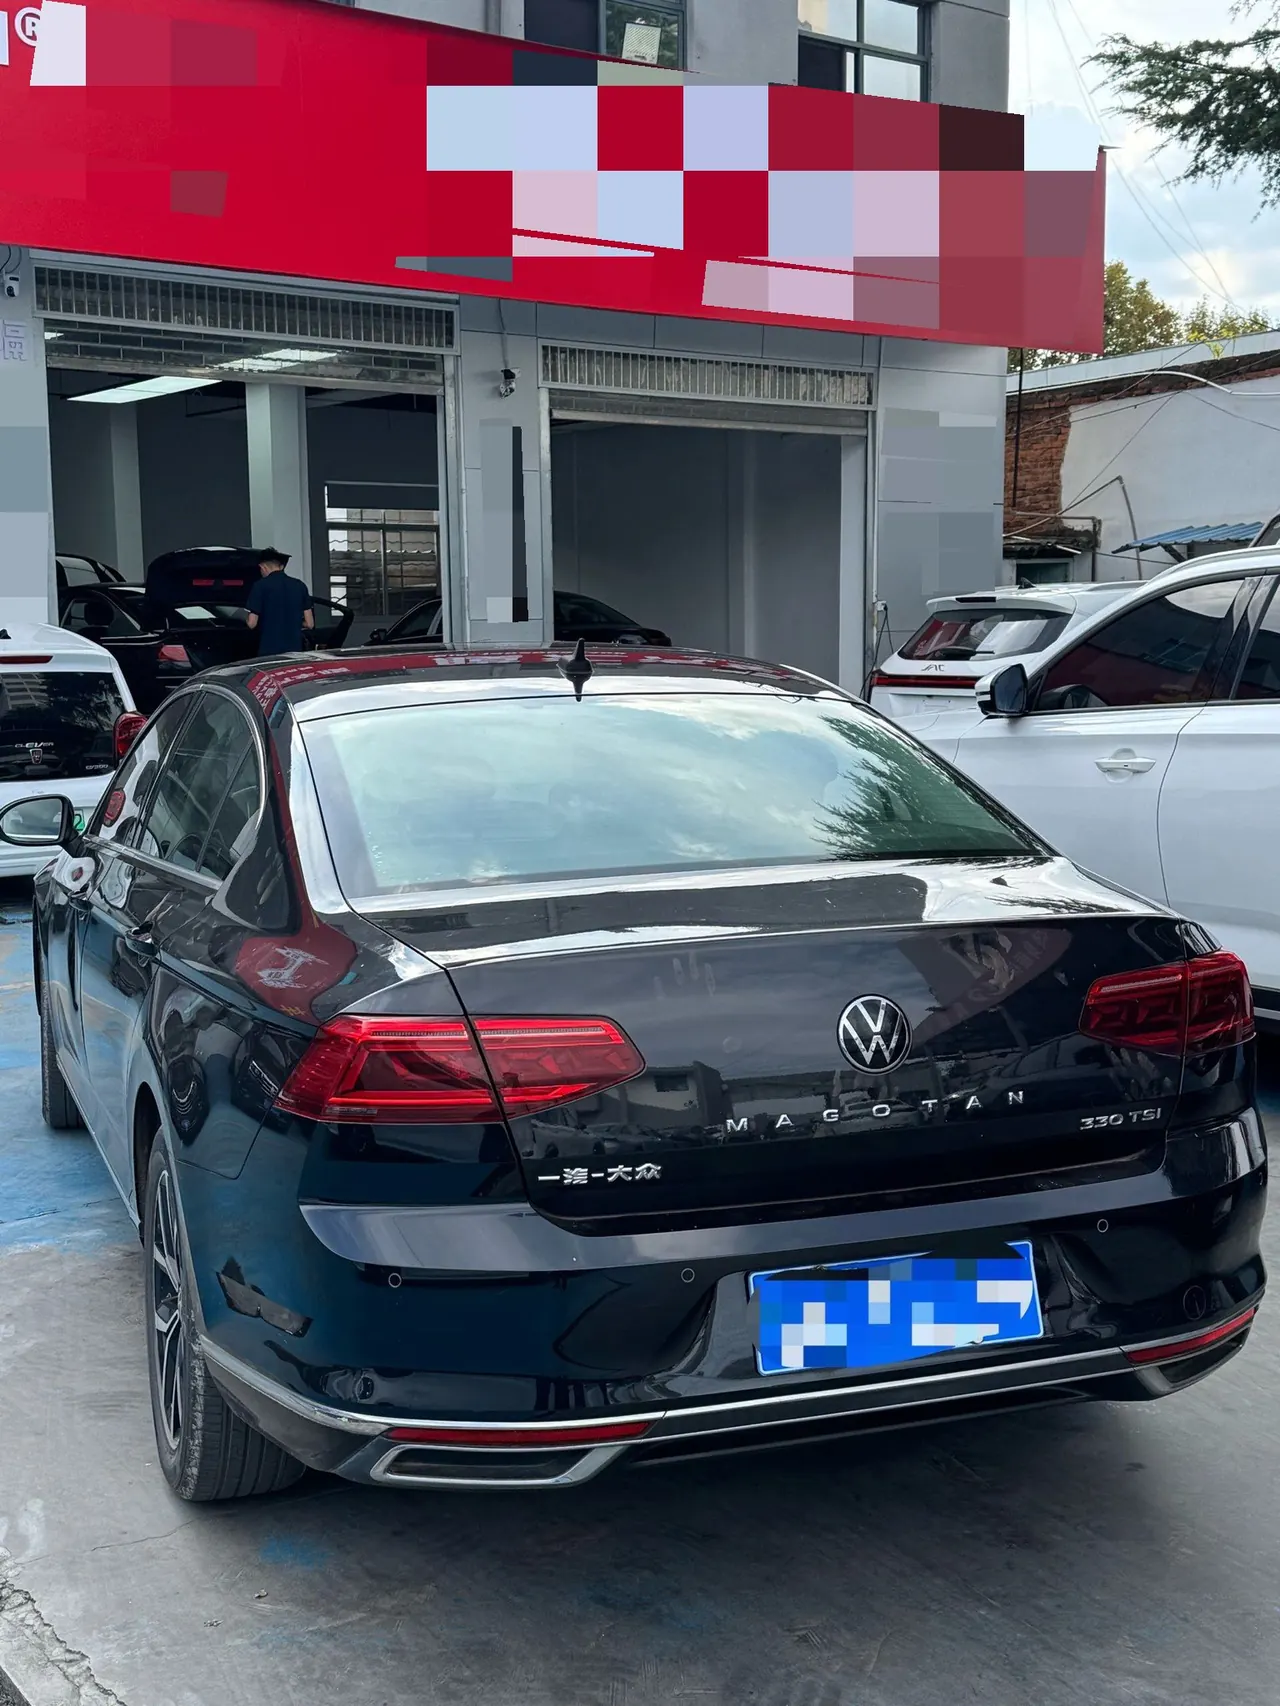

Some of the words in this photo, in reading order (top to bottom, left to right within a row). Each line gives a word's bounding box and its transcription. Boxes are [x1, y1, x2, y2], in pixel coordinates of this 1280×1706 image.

[726, 1091, 1024, 1132] MAGOTAN
[1080, 1113, 1124, 1130] 330
[1128, 1107, 1162, 1122] TSI
